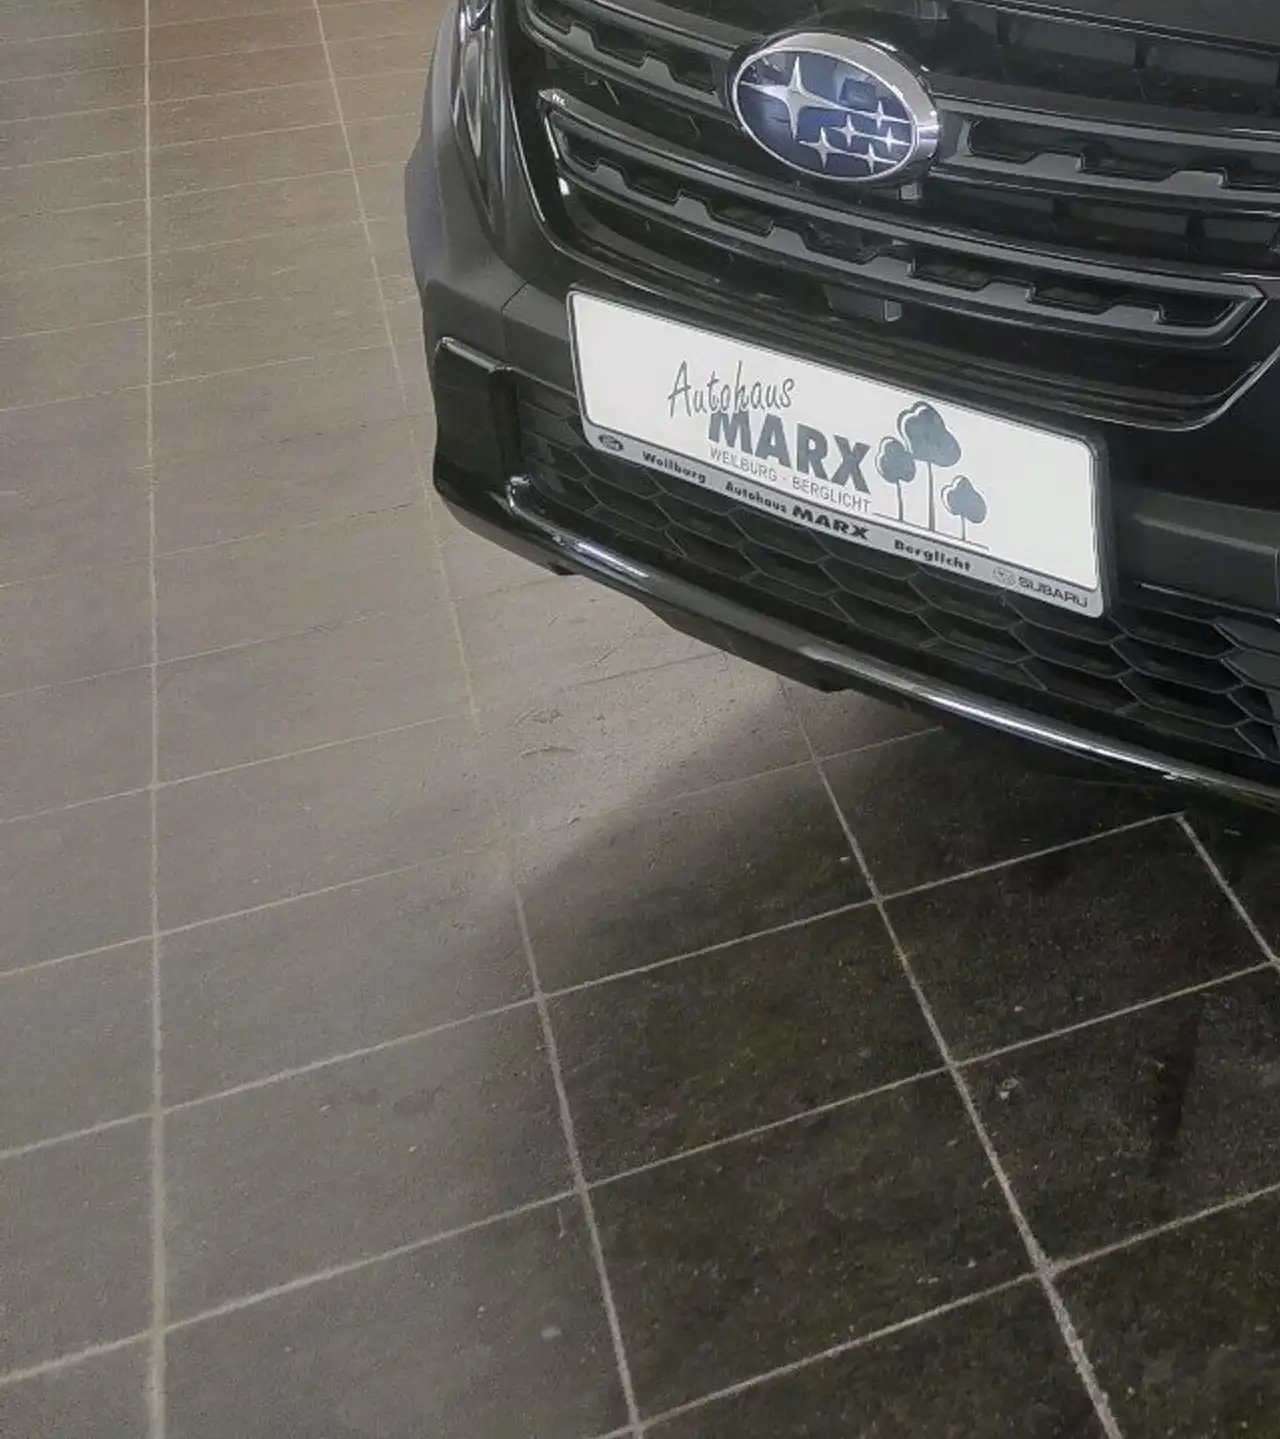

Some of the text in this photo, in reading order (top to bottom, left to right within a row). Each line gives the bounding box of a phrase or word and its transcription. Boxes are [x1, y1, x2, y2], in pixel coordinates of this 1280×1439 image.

[667, 360, 795, 418] Autohaus
[708, 409, 872, 494] MARX
[709, 445, 778, 482] WEILBURG
[792, 476, 872, 514] BERGLICHT
[642, 450, 1088, 608] Weilburg Autohaus MARX Berglicht SUBARU
